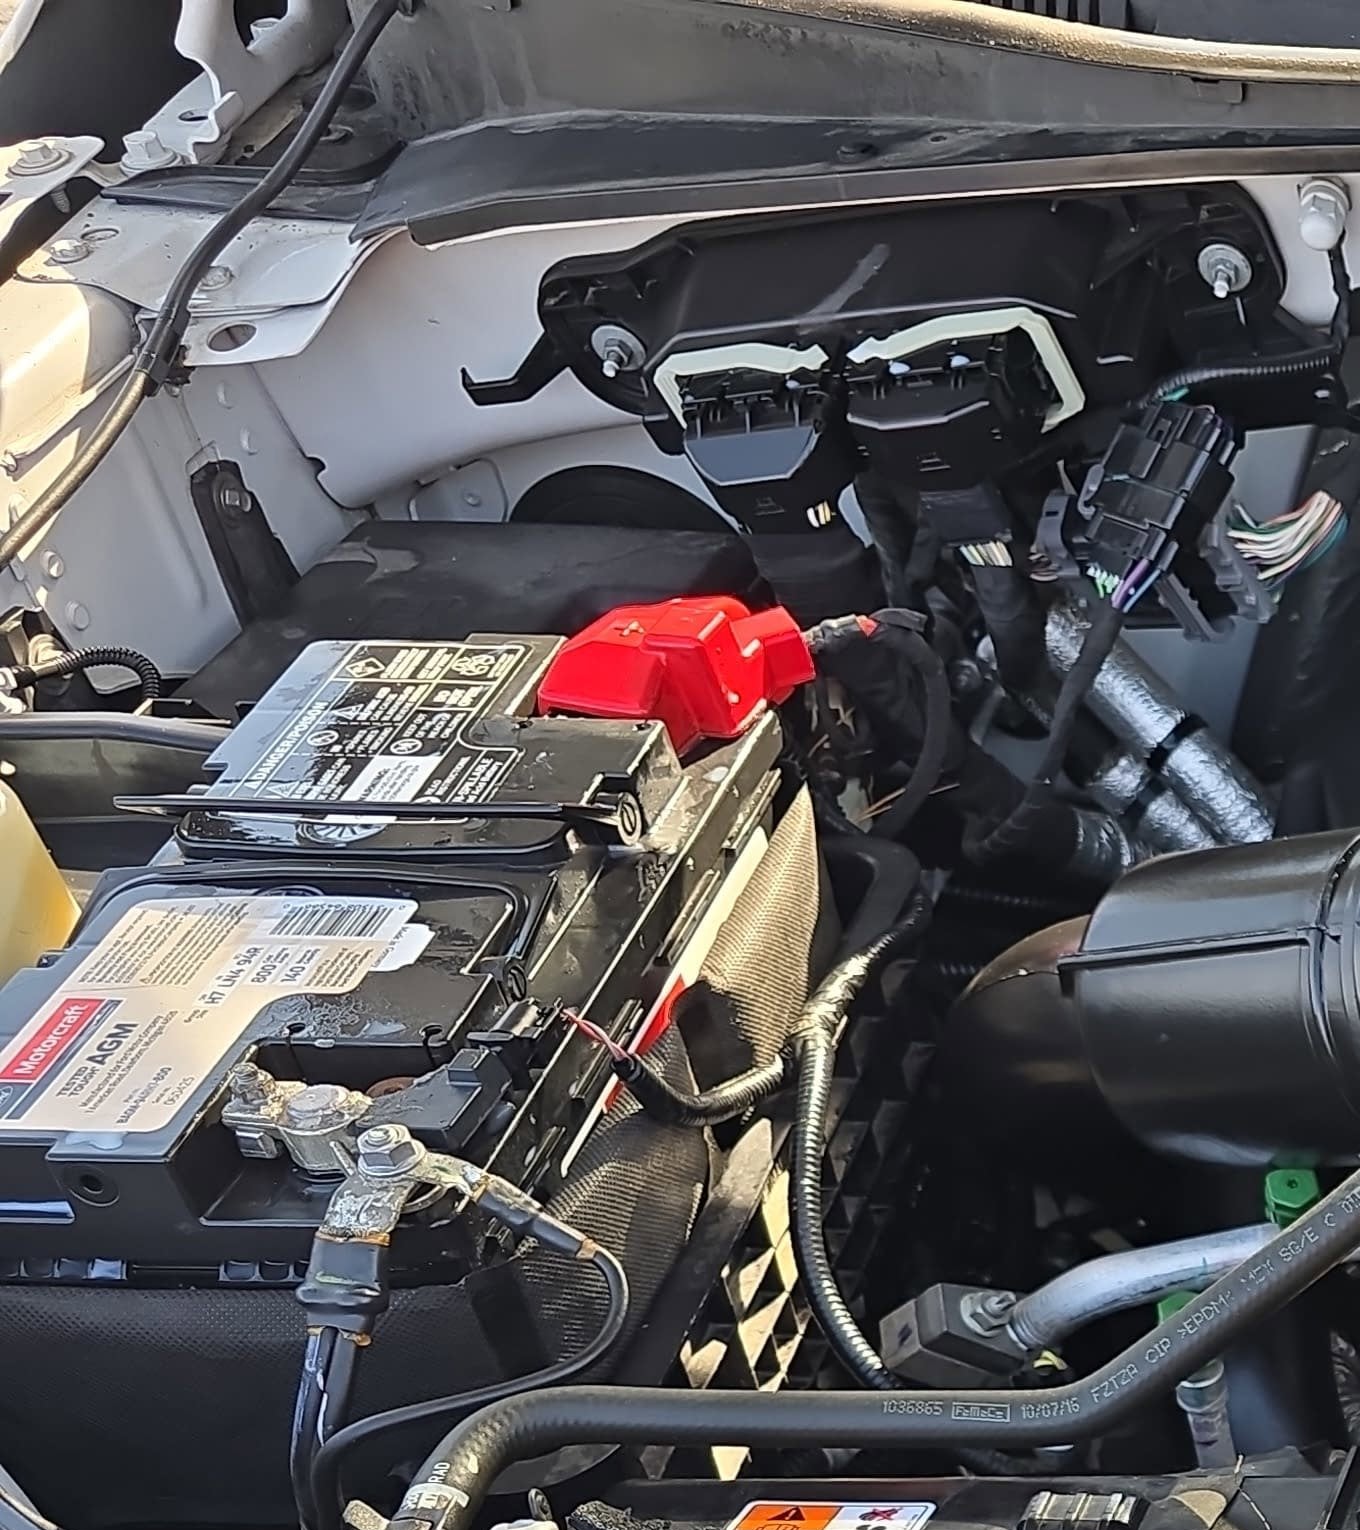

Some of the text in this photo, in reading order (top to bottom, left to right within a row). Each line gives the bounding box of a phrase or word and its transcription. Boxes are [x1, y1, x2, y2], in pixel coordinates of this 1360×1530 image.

[256, 701, 329, 780] DANGER/POISON
[206, 947, 264, 1005] H7 LN4 94R
[251, 965, 275, 983] 800
[282, 966, 304, 983] 140
[13, 1004, 88, 1074] Motorcraft
[56, 1023, 139, 1096] TESTED AGM
[883, 1400, 944, 1416] 1036865
[1145, 1337, 1172, 1364] CIP
[1279, 1227, 1319, 1263] SG/E
[1324, 1213, 1336, 1227] C
[428, 1462, 451, 1483] RAD
